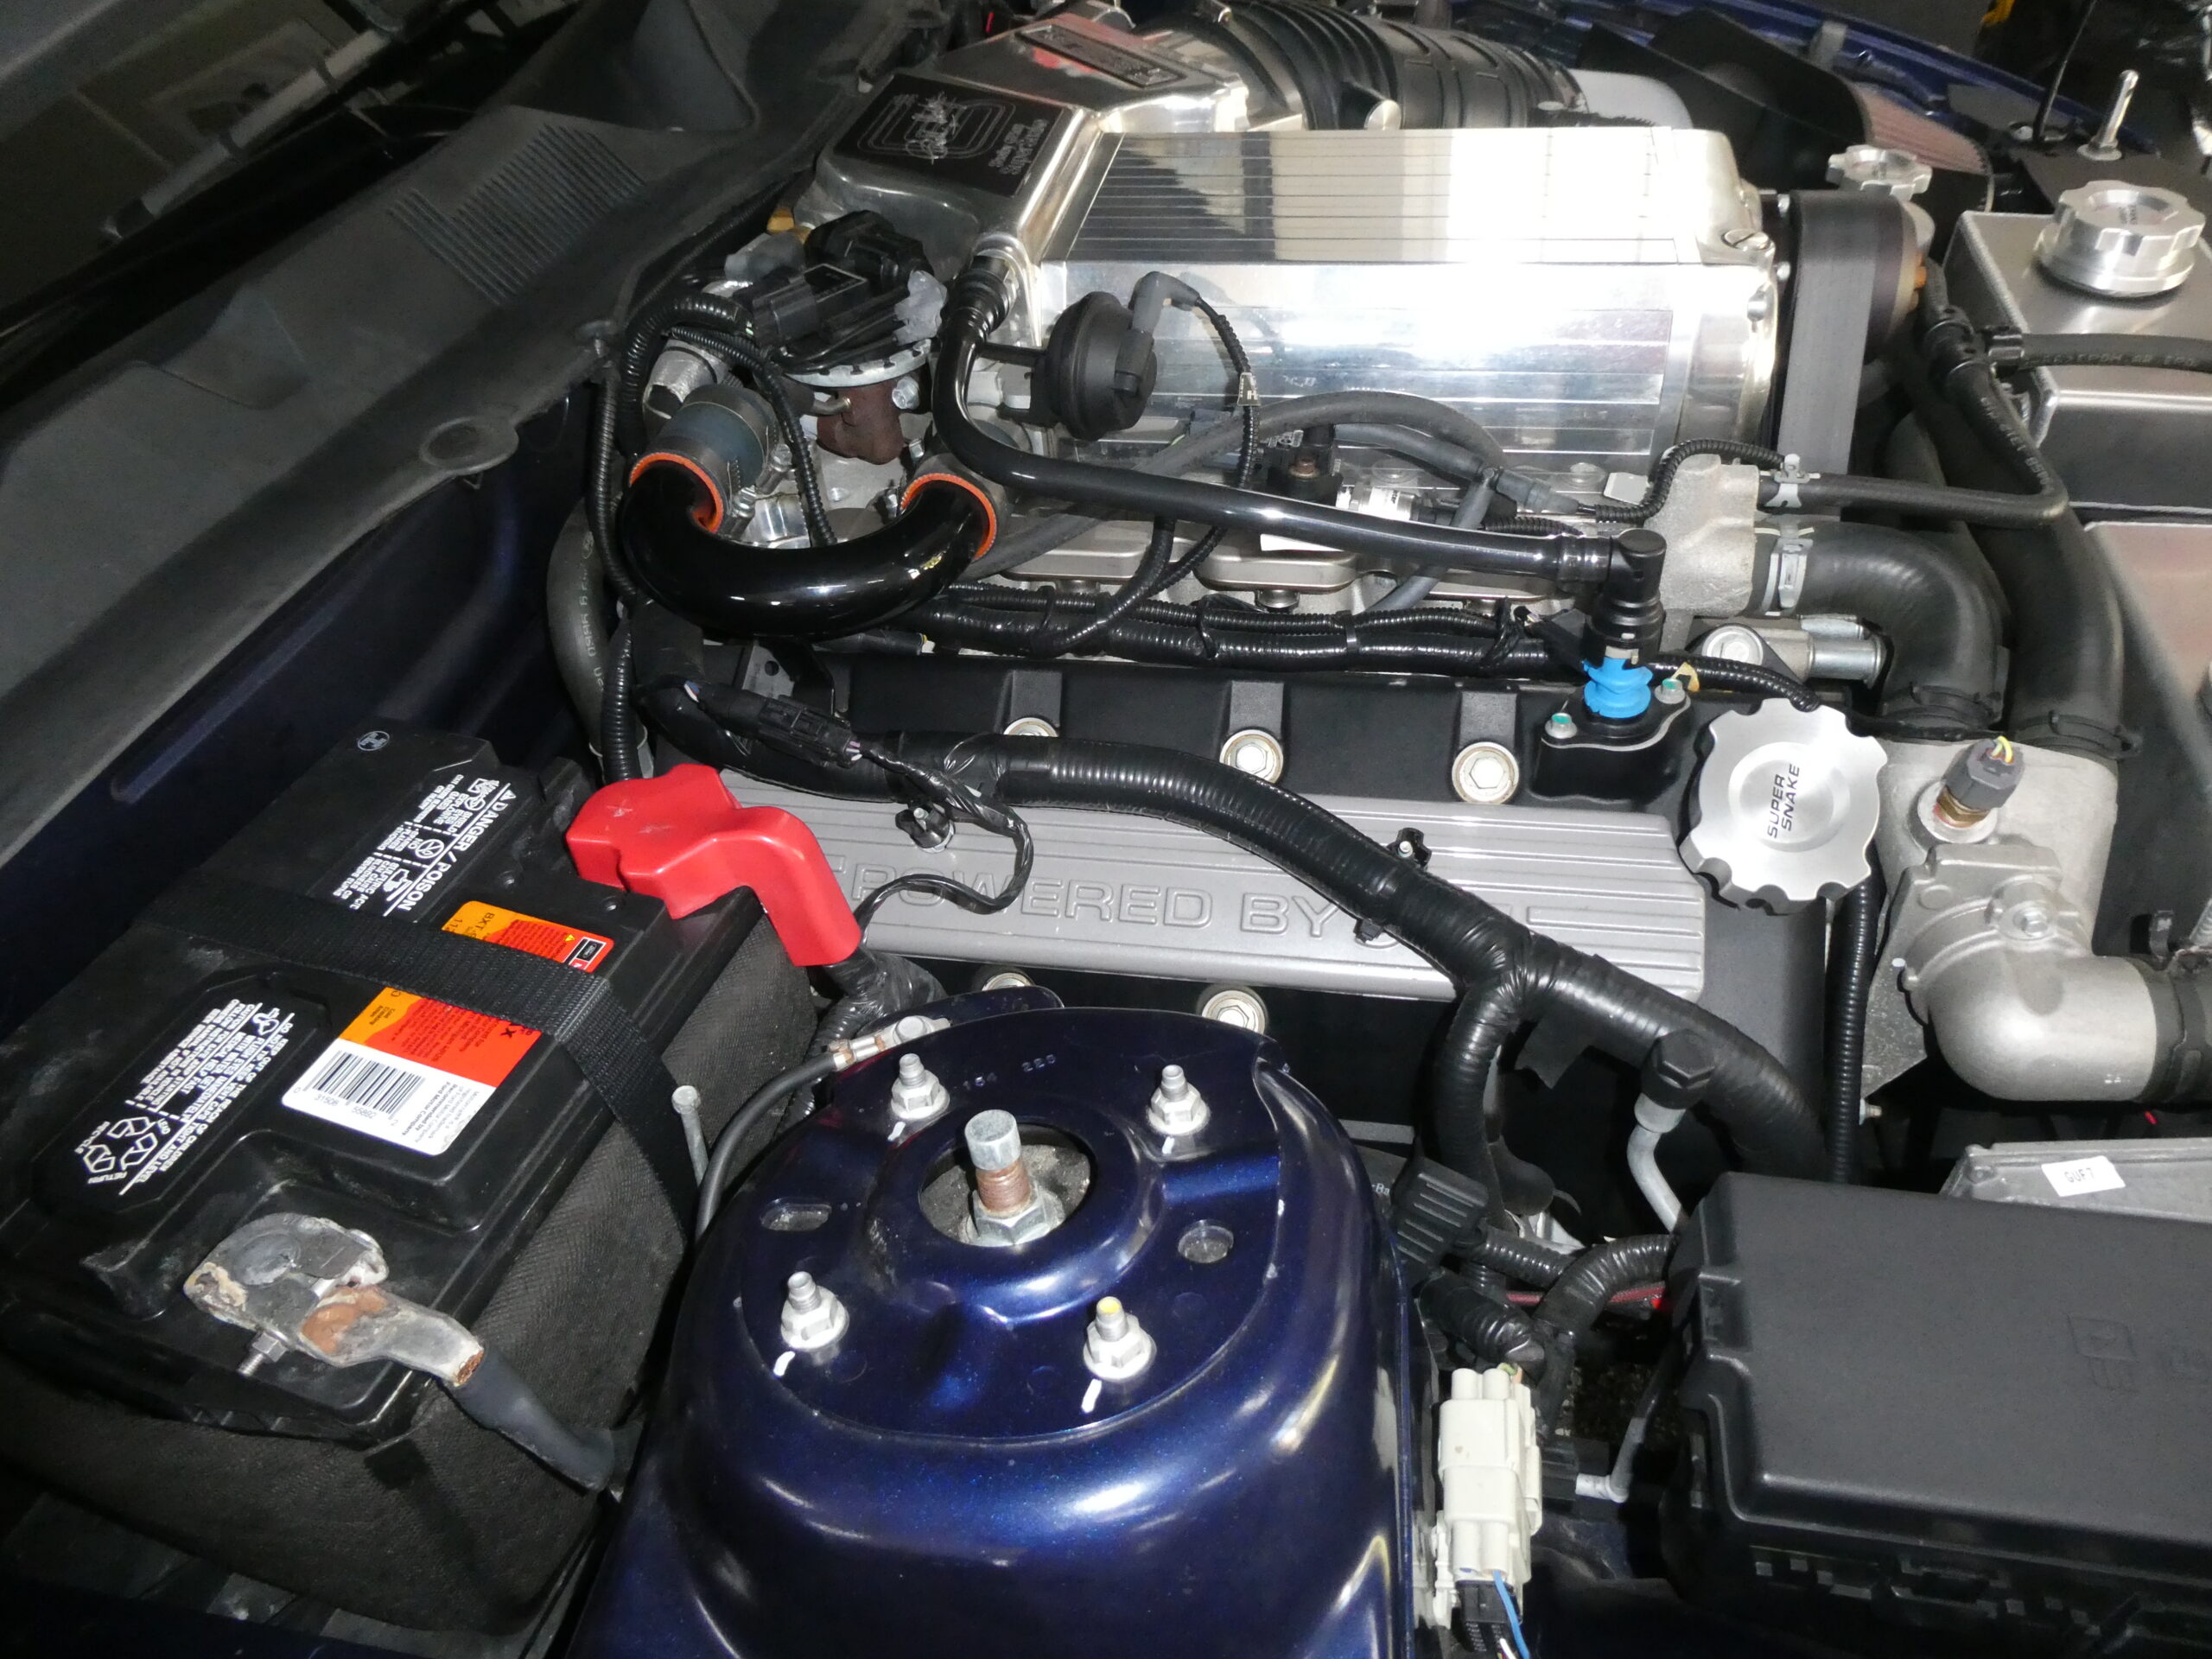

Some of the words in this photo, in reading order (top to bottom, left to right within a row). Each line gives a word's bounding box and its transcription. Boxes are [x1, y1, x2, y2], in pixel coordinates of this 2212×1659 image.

[435, 791, 461, 810] GASES
[1767, 773, 1786, 838] SUPER
[1781, 764, 1800, 831] SNAKE
[431, 792, 470, 825] EXPLOSIVE
[443, 808, 465, 824] EYES
[452, 800, 509, 851] DANGER
[406, 837, 423, 849] NO
[448, 850, 457, 862] /
[396, 861, 452, 911] POISON
[1241, 893, 1338, 938] BY
[278, 1021, 294, 1033] DO
[213, 1030, 246, 1059] MEDICAL
[232, 1033, 257, 1052] WITH
[238, 1036, 266, 1058] FLUSH
[263, 1033, 283, 1049] NOT
[266, 1037, 289, 1056] KEEP
[195, 1058, 220, 1077] HELP
[222, 1057, 245, 1076] EYES
[232, 1062, 255, 1082] KEEP
[251, 1055, 272, 1072] OUT
[178, 1075, 202, 1095] FAST
[195, 1074, 216, 1090] GET
[241, 1071, 257, 1083] OF
[214, 1080, 238, 1101] VENT
[226, 1082, 247, 1098] THE
[435, 1080, 451, 1094] Ford
[178, 1075, 228, 1121] IMMEDIATELY
[420, 1083, 458, 1124] Recommended
[422, 1093, 441, 1110] Motor
[195, 1099, 219, 1121] CAPS
[202, 1096, 233, 1124] REACH
[174, 1121, 200, 1142] TIGHT
[192, 1122, 209, 1135] OF
[400, 1109, 427, 1136] Company
[413, 1122, 425, 1131] by
[74, 1121, 110, 1154] RECYCLE
[157, 1143, 178, 1160] AND
[157, 1134, 198, 1172] CHILDREN
[87, 1171, 128, 1184] RETURN
[134, 1160, 162, 1185] LEVEL
